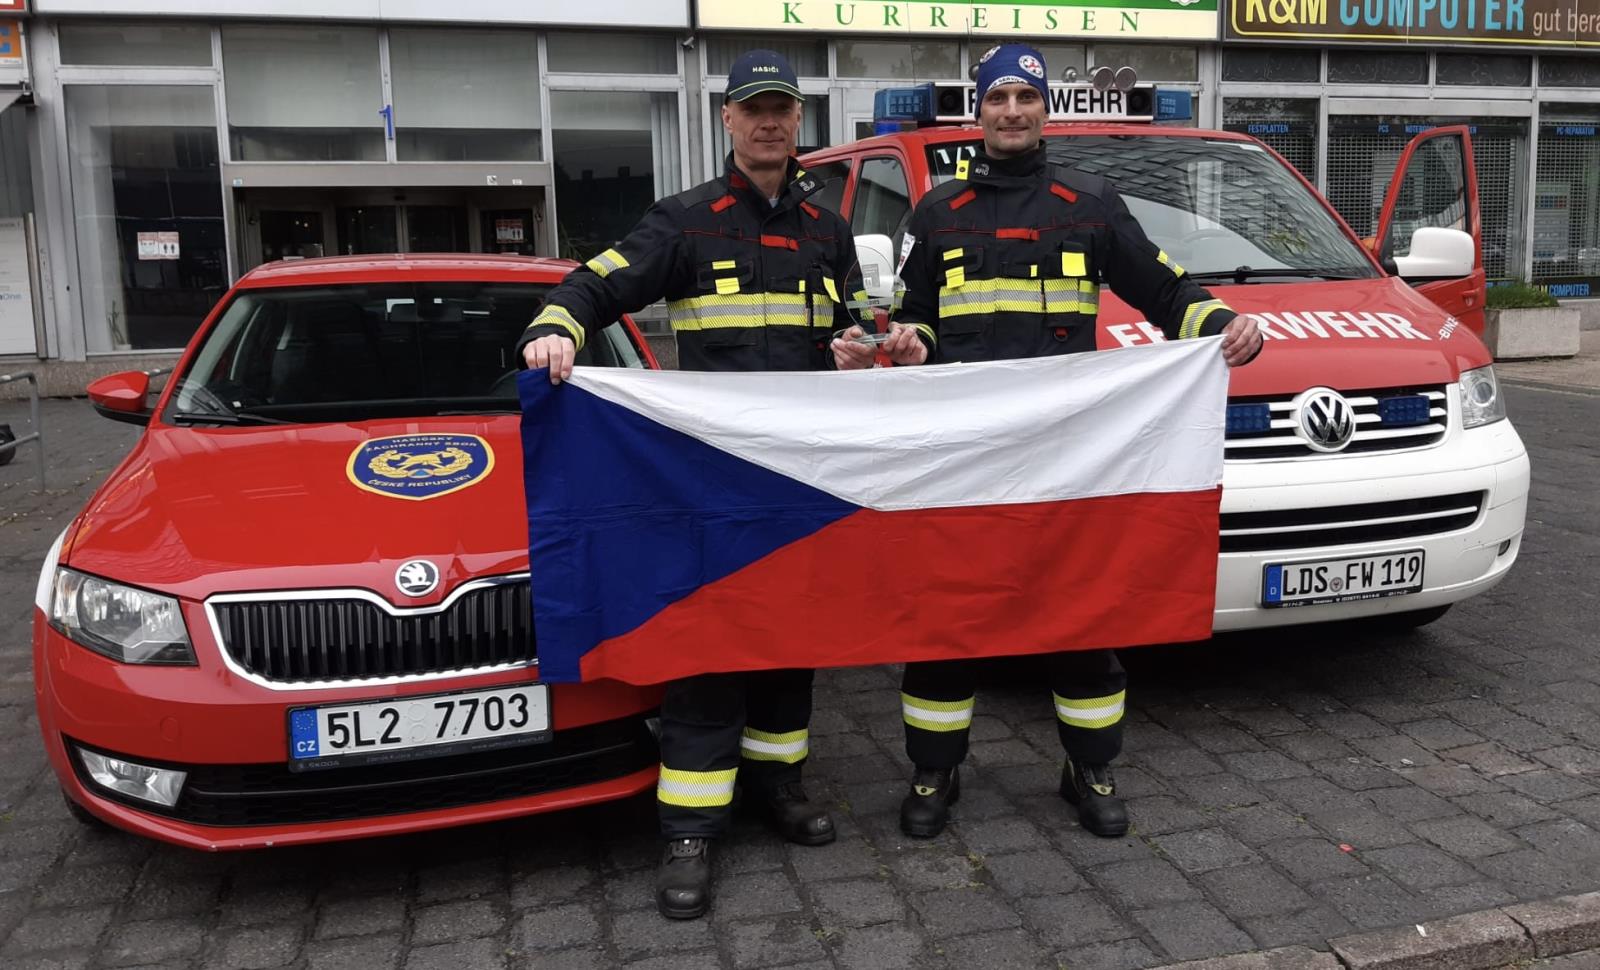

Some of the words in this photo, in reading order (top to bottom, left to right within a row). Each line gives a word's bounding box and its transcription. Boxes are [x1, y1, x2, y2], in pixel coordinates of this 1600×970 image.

[782, 2, 1140, 32] KURREISEN
[1246, 0, 1327, 24] K&M
[1339, 0, 1524, 31] COMPUTER
[1533, 8, 1561, 37] gut
[378, 104, 393, 140] 1
[1248, 124, 1289, 133] FESTPLATTEN
[1548, 284, 1590, 296] COMPUTER
[407, 474, 472, 487] REPUBLIKY
[1283, 566, 1328, 595] LDS
[1345, 561, 1375, 590] FW
[1380, 556, 1420, 586] 119
[1270, 587, 1277, 595] D
[327, 708, 402, 749] 5L2
[433, 693, 529, 739] 7703
[297, 741, 316, 753] CZ
